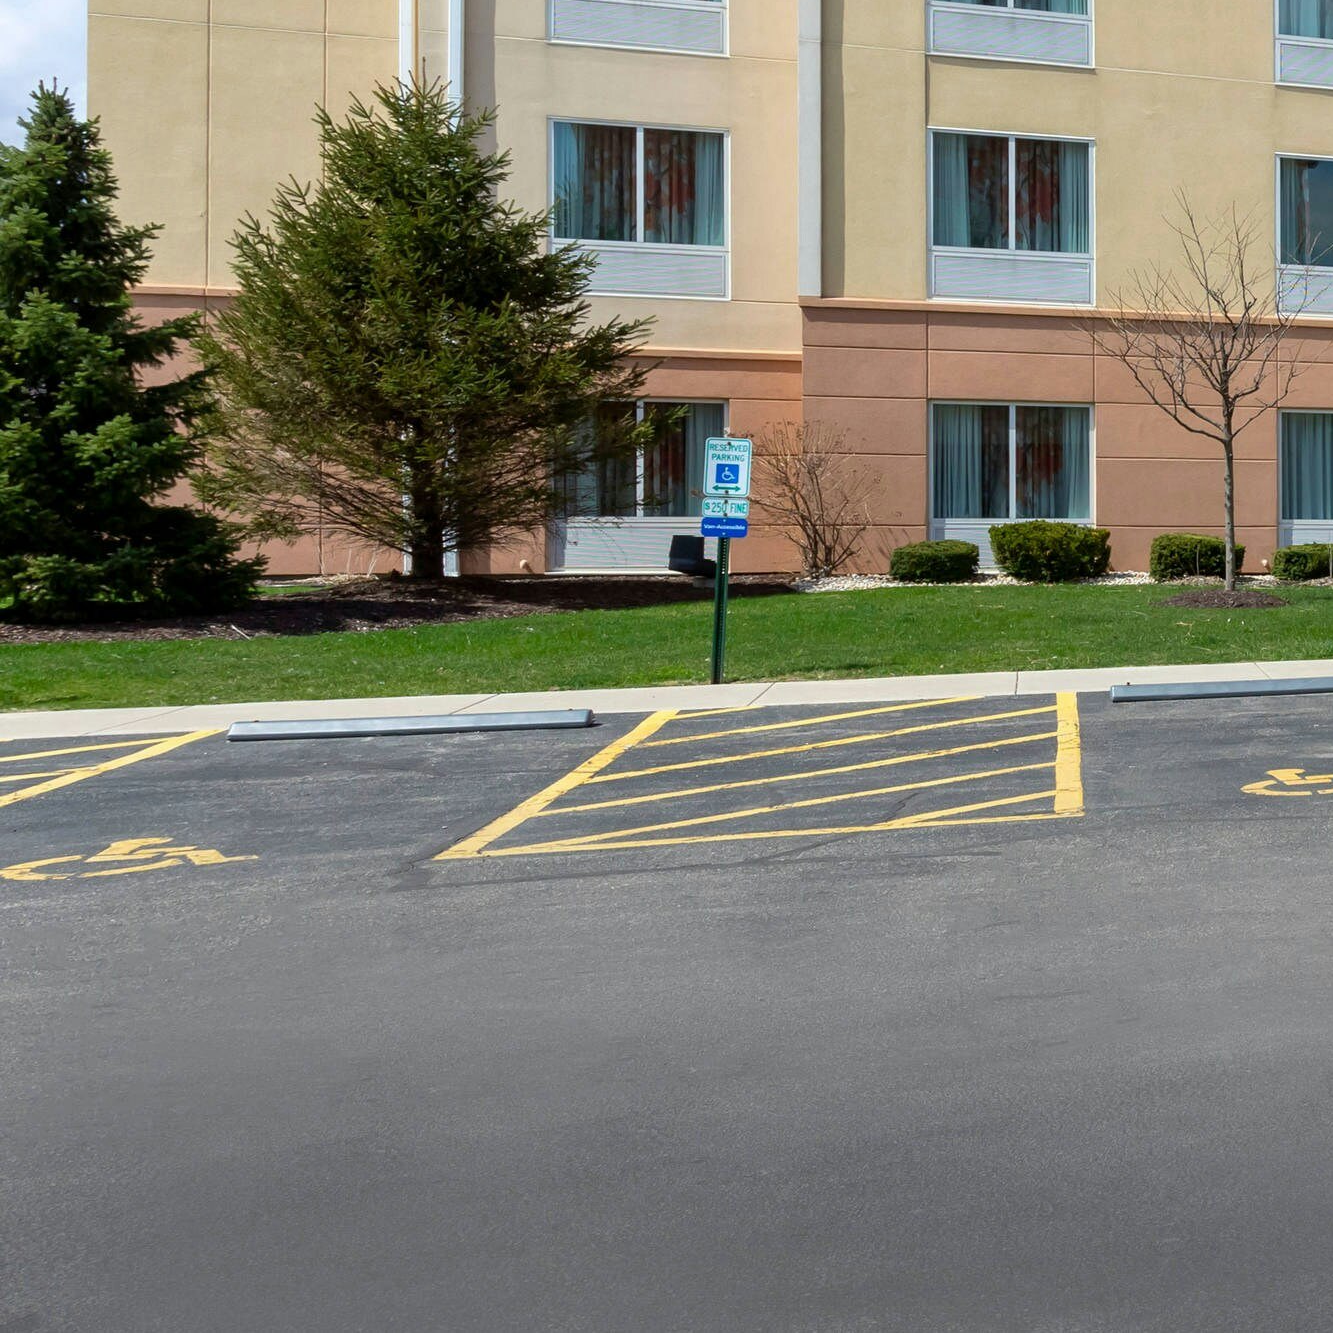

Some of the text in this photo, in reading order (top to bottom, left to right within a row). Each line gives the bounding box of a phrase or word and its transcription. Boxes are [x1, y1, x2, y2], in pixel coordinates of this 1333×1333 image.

[709, 443, 748, 453] RESERVED
[711, 454, 745, 462] PARKING
[730, 502, 748, 514] FINE
